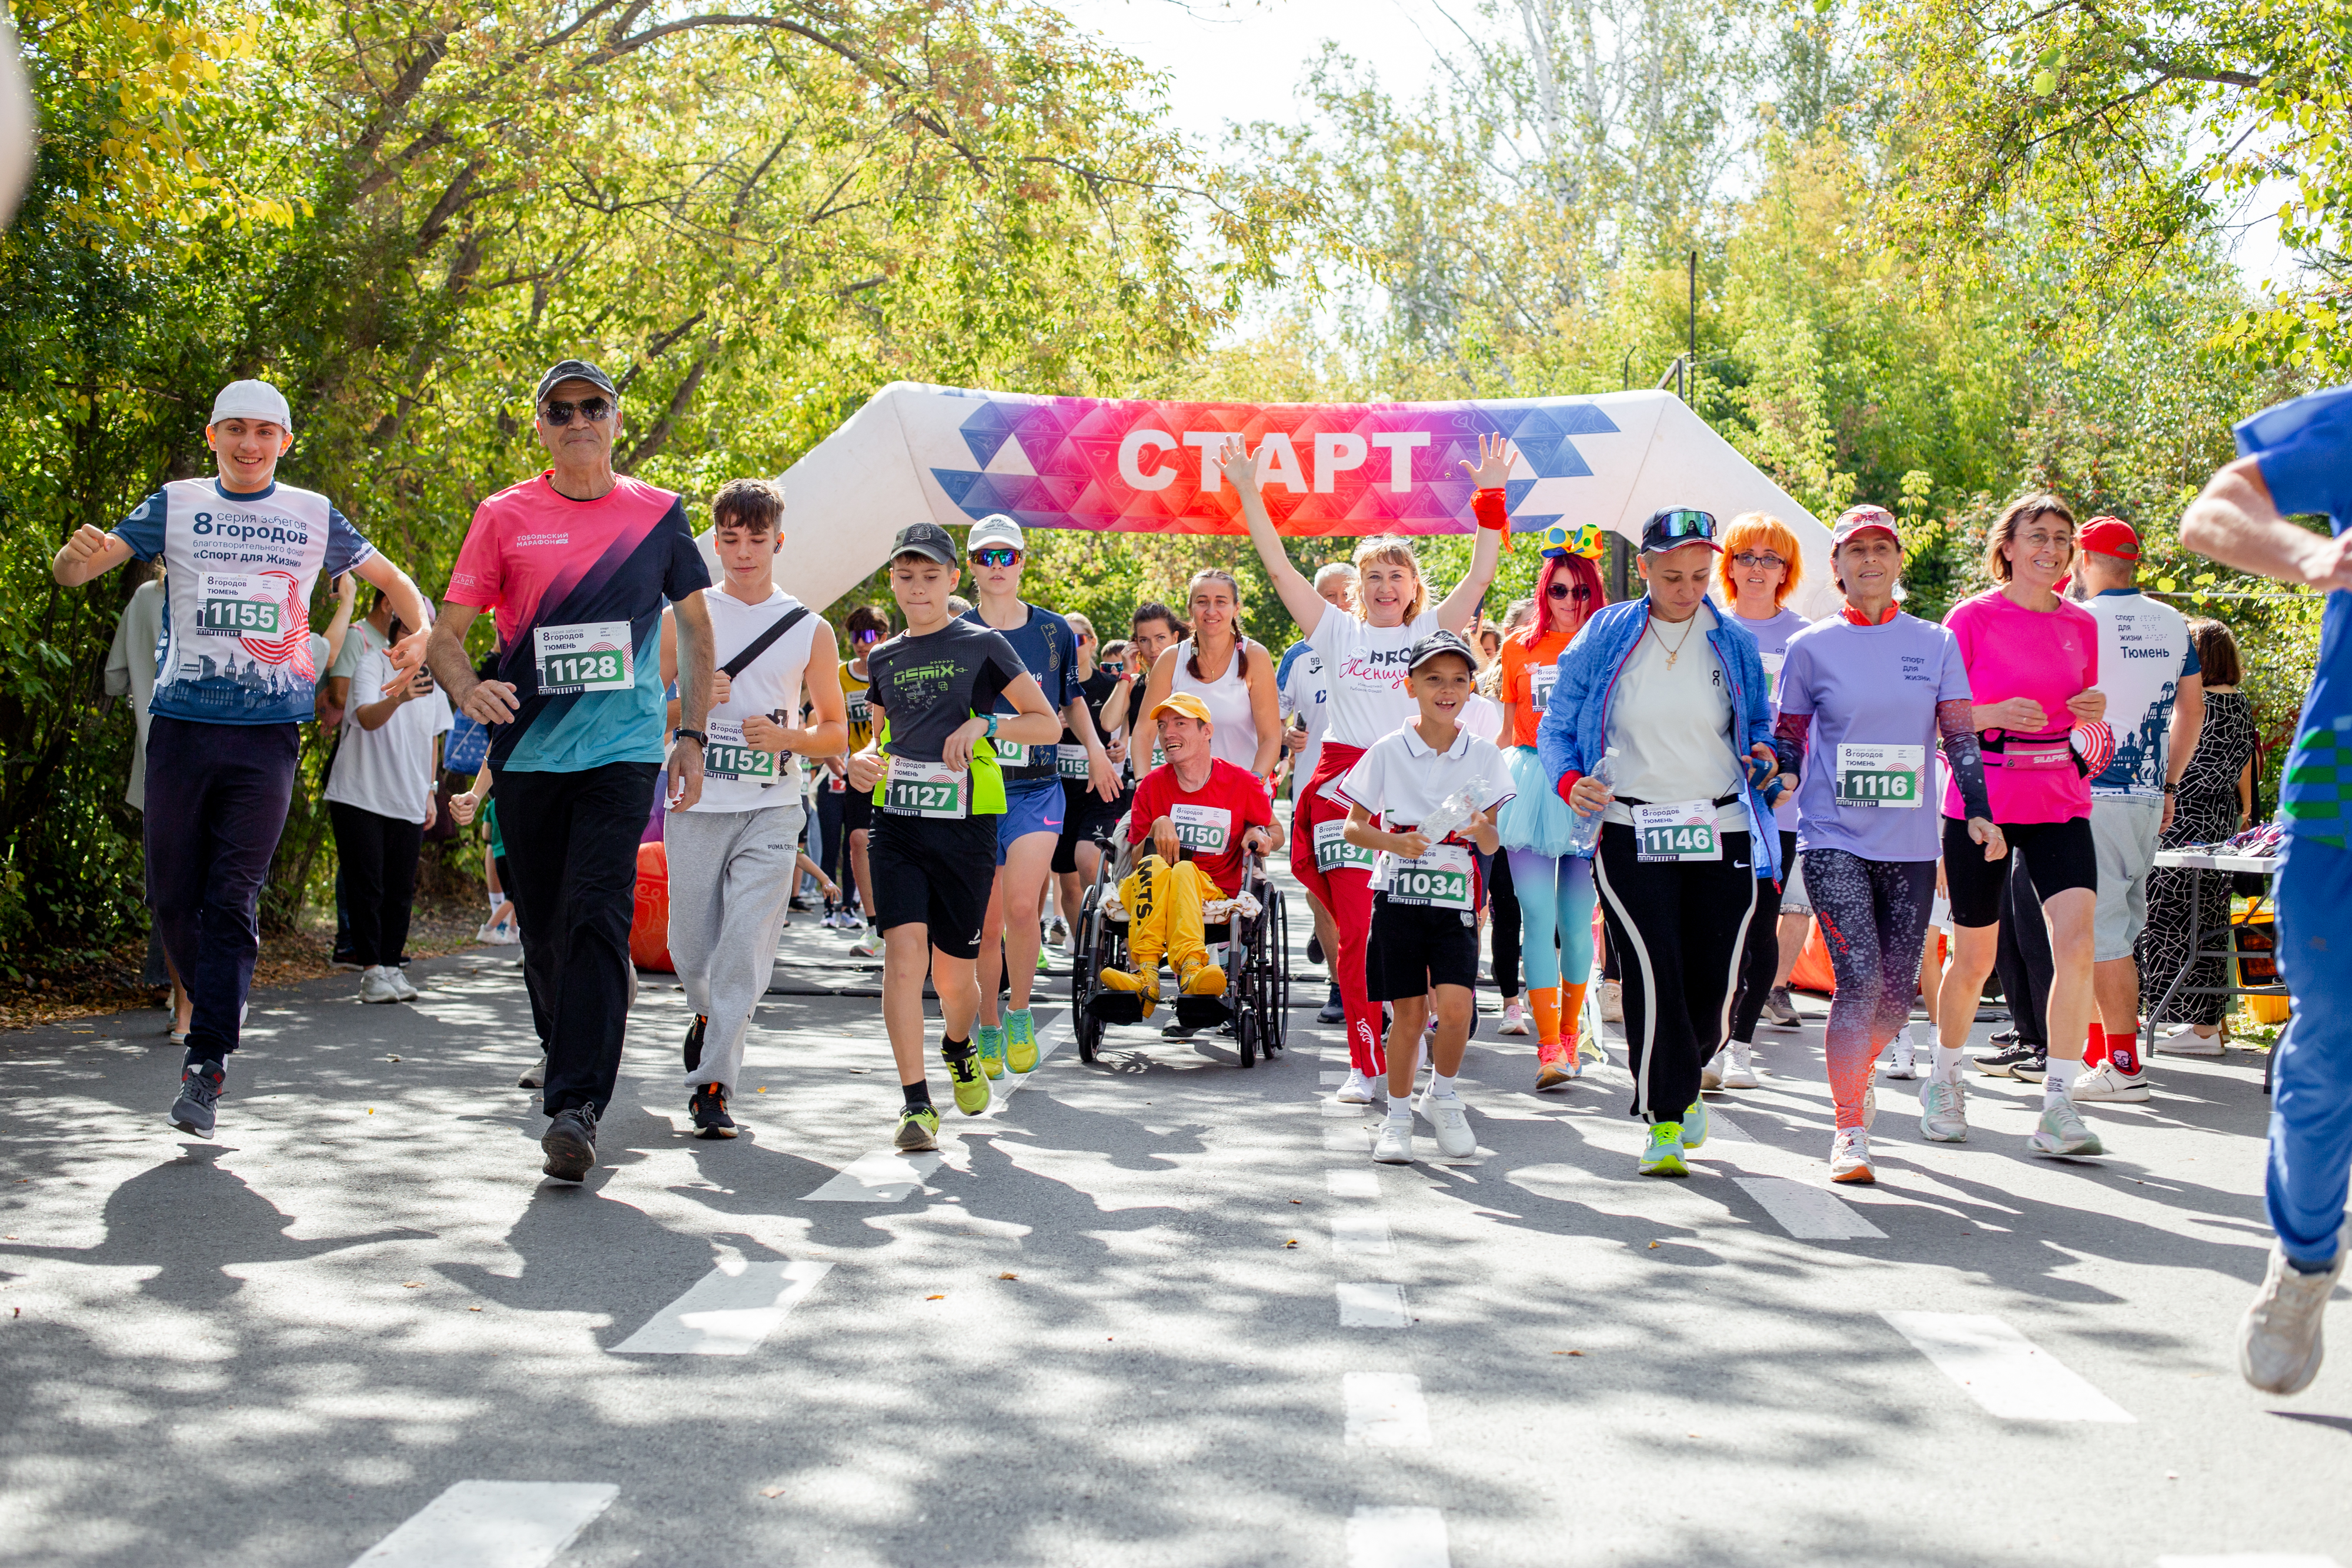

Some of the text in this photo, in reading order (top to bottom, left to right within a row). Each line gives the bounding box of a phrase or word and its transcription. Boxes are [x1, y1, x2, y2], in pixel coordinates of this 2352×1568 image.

[1118, 429, 1431, 493] СТАРТ
[193, 512, 308, 545] 8 городов
[217, 513, 307, 530] серия забегов
[517, 532, 569, 541] ТОБОЛЬСКИЙ
[517, 539, 555, 547] МАРАФОН
[193, 540, 305, 557] благотворительного фонда
[193, 550, 302, 567] «Спорт для Жизни»
[208, 576, 214, 585] 8
[211, 602, 274, 628] 1155
[543, 632, 584, 641] 8 городов
[544, 643, 576, 651] ТЮМЕНЬ
[2120, 646, 2170, 658] Тюмень
[551, 656, 617, 682] 1128
[1339, 657, 1408, 689] Женщи
[712, 747, 769, 773] 1152
[897, 784, 951, 807] 1127
[1852, 775, 1907, 796] 1116
[1177, 825, 1221, 845] 1150
[1648, 828, 1710, 850] 1146
[1324, 843, 1368, 861] 1137
[1399, 873, 1464, 898] 1034
[1821, 912, 1846, 943] CRAFT
